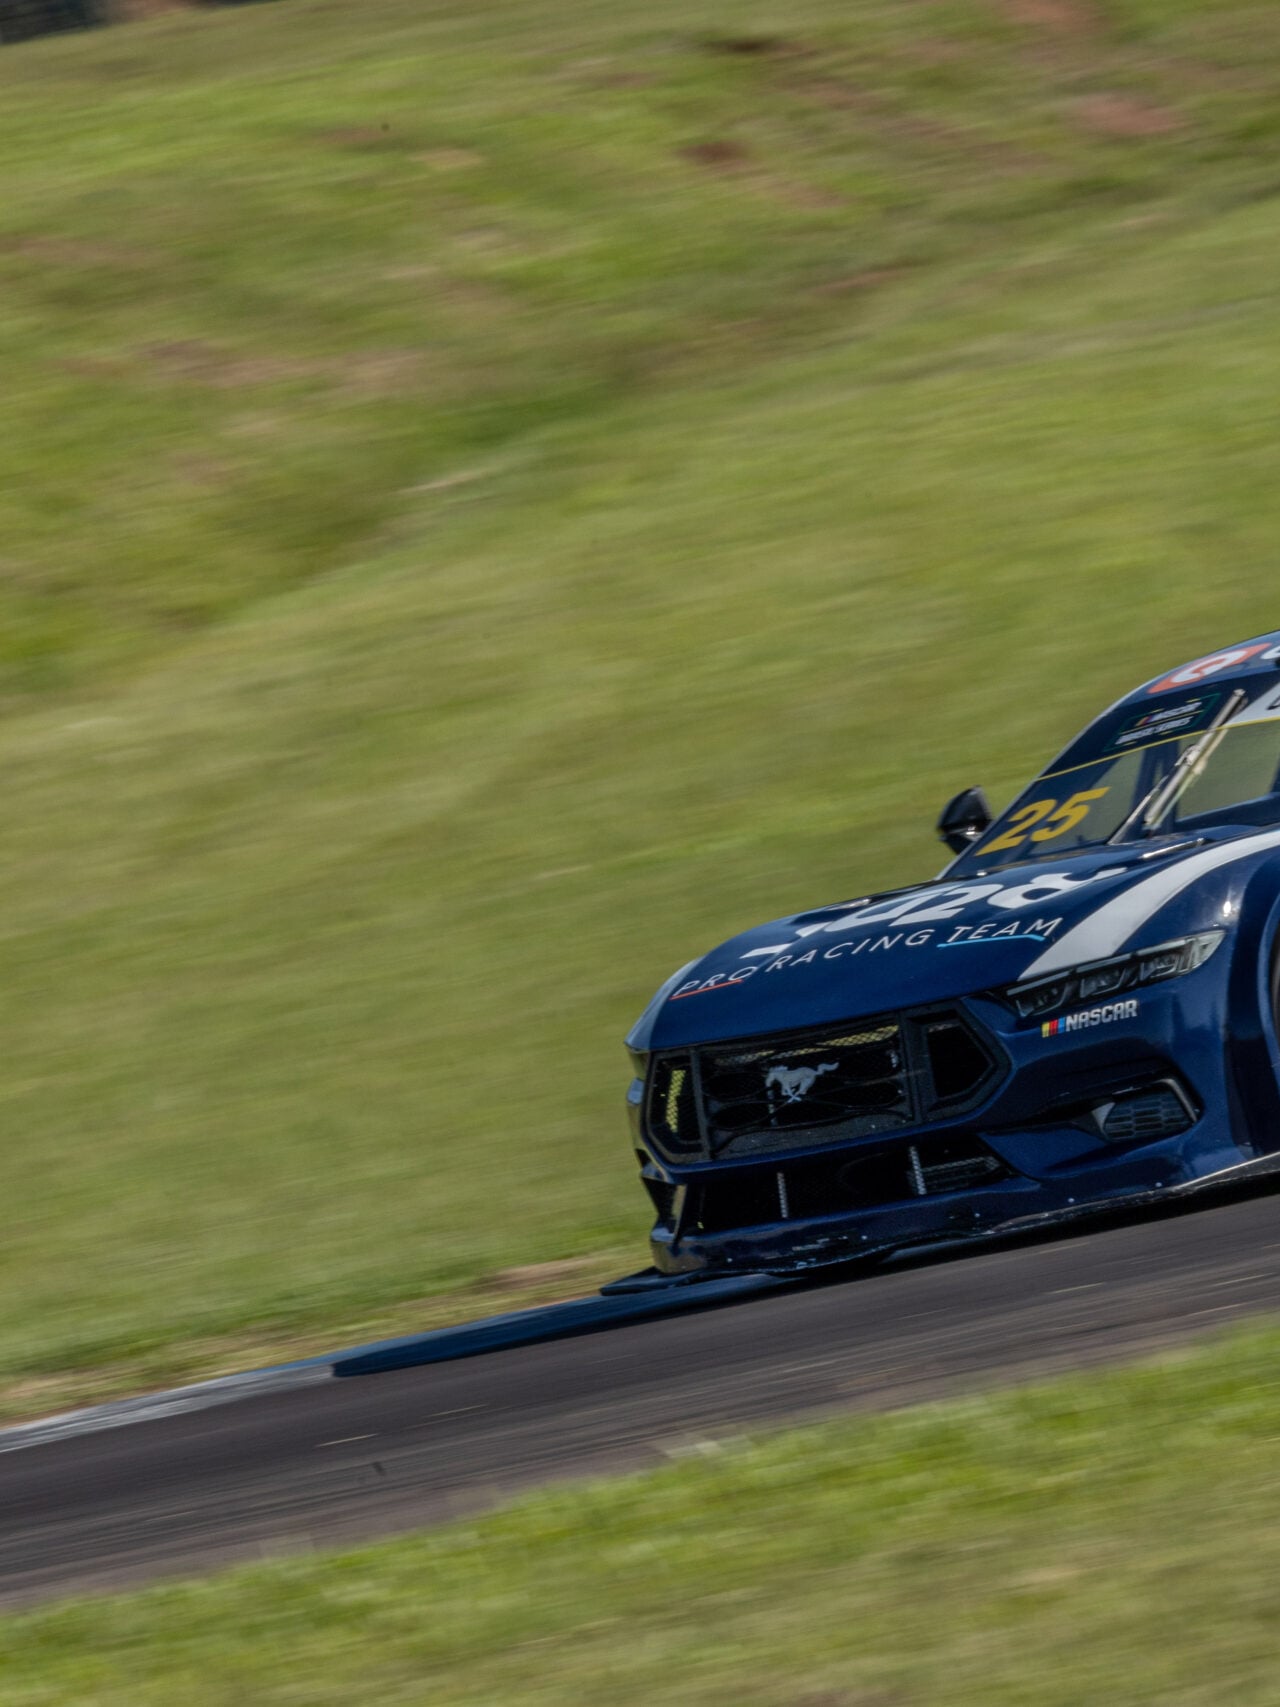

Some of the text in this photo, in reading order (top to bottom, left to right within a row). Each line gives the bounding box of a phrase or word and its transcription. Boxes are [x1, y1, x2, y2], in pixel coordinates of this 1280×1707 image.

[974, 786, 1111, 856] 25
[676, 916, 1063, 996] PRO RACING TEAM
[1065, 999, 1138, 1031] NASCAR
